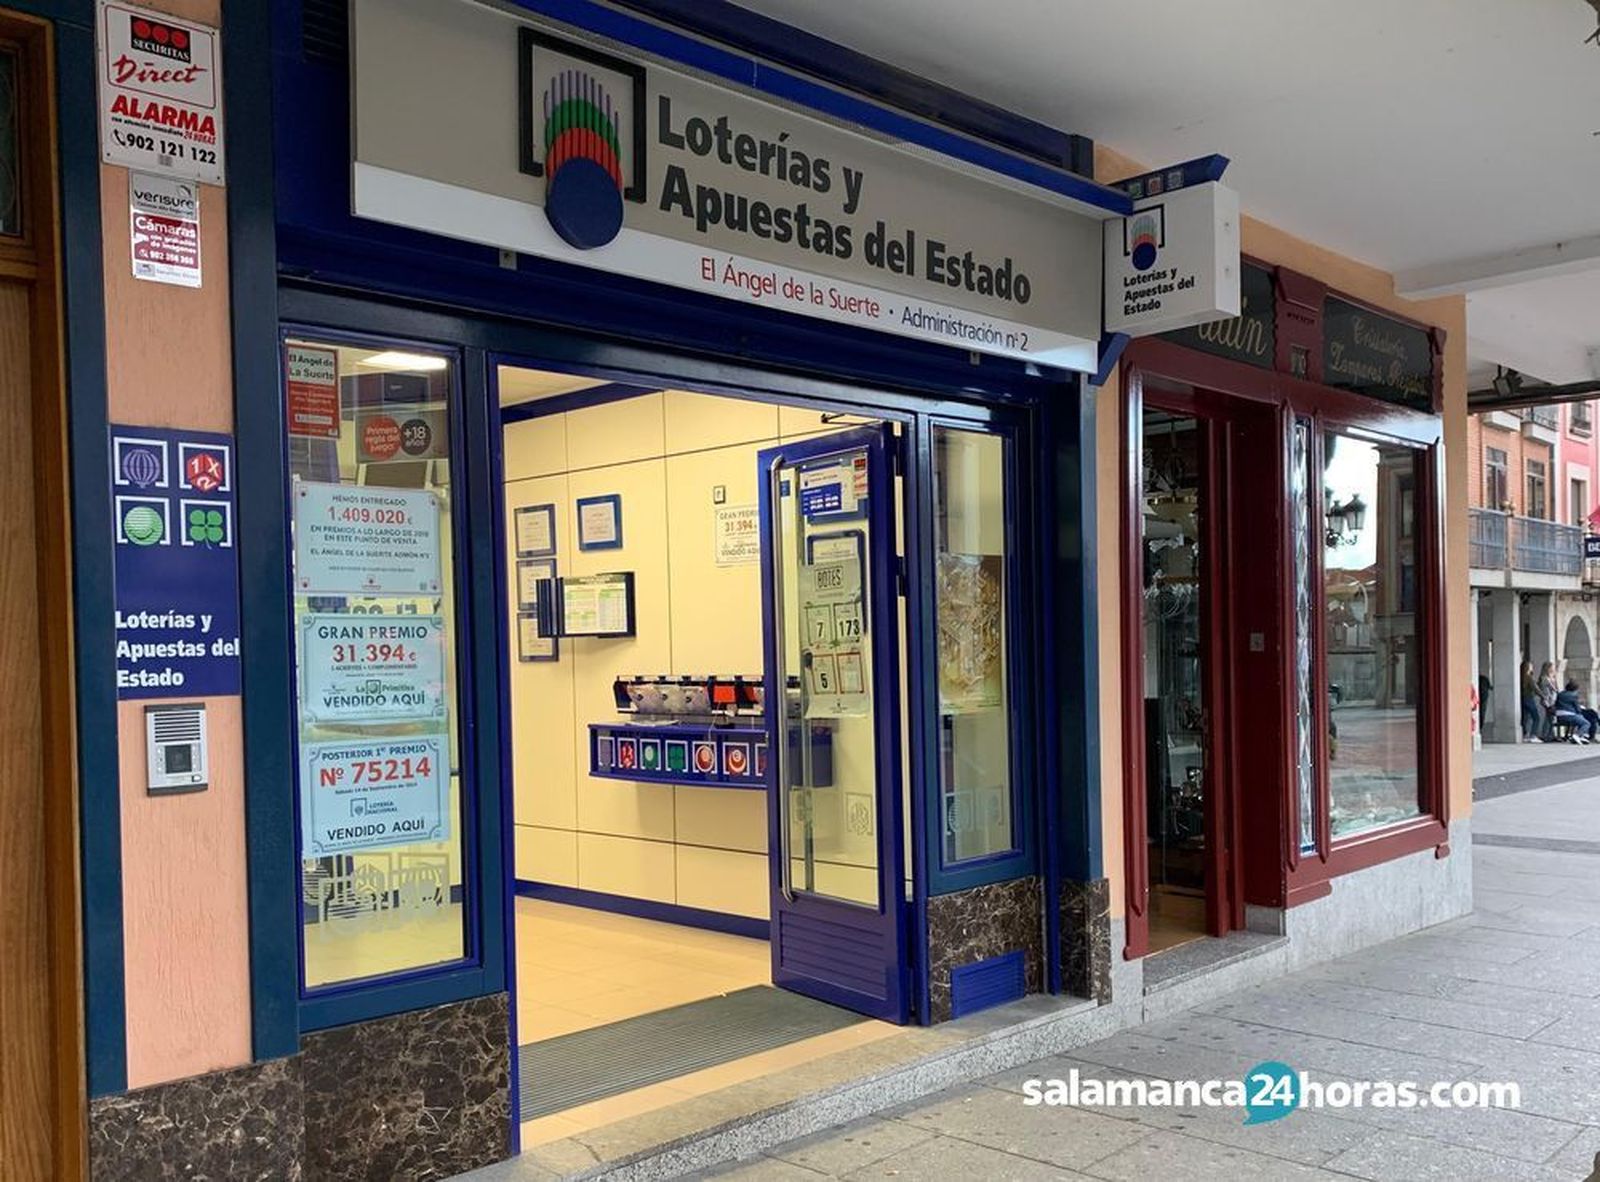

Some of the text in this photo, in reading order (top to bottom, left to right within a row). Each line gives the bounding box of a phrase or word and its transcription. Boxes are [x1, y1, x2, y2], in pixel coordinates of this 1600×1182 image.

[133, 38, 190, 60] SECURITAS
[112, 54, 208, 84] Direct
[110, 94, 216, 137] ALARMA
[126, 133, 216, 165] 902 121 122
[658, 95, 864, 215] Loterías y
[134, 189, 195, 209] verisure
[135, 216, 196, 239] Cámaras
[659, 163, 1031, 304] Apuestas del Estado
[1169, 267, 1177, 280] y
[1124, 276, 1195, 302] Apuestas del
[700, 256, 716, 282] El
[723, 256, 777, 302] Ángel
[782, 276, 805, 301] de
[809, 281, 824, 305] la
[829, 286, 881, 318] Suerte
[901, 303, 1003, 347] Administración
[1123, 298, 1161, 316] Estado
[403, 426, 426, 440] +18
[361, 497, 407, 506] ENTREGADO
[328, 506, 405, 524] 1.409.020
[817, 568, 841, 588] BOTES
[115, 610, 213, 633] Loterías y
[318, 625, 428, 639] GRAN PREMIO
[817, 622, 824, 638] 7
[115, 638, 240, 663] Apuestas del
[332, 644, 405, 663] 31.394
[116, 668, 185, 689] Estado
[322, 690, 426, 708] VENDIDO AQUÍ
[321, 750, 373, 761] POSTERIOR
[389, 744, 427, 755] PREMIO
[320, 756, 431, 787] Nº 75214
[327, 823, 386, 841] VENDIDO
[392, 817, 426, 833] AQUÍ
